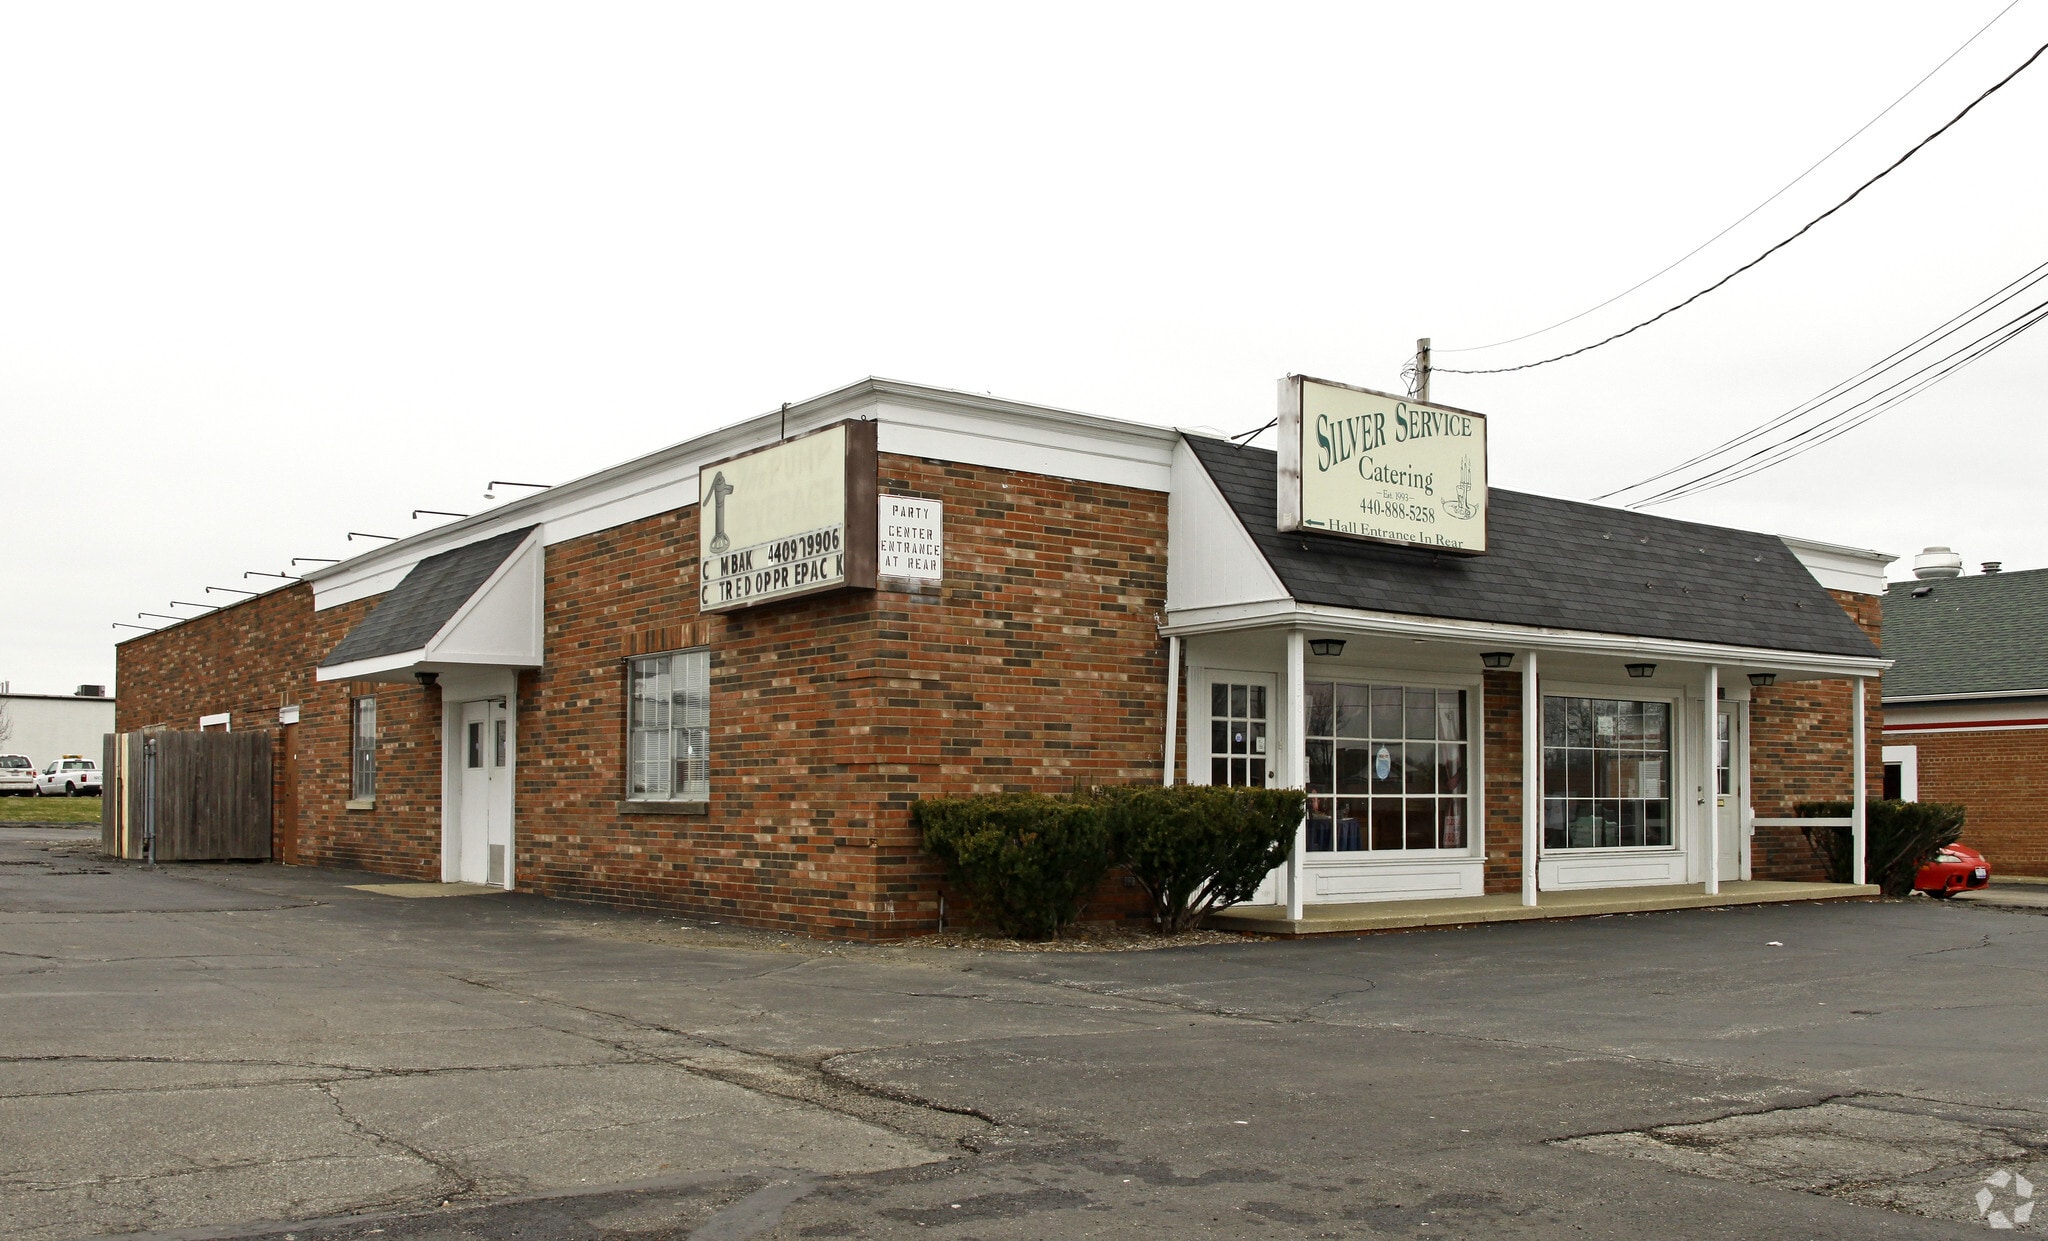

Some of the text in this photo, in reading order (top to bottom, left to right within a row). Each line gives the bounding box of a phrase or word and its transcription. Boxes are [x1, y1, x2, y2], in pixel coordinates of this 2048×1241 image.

[1316, 402, 1473, 472] SILVER SERVICE
[1358, 455, 1434, 496] Catering
[892, 504, 929, 520] PARTY
[1359, 497, 1435, 524] 440-888-5258
[888, 525, 933, 540] CENTER
[1328, 518, 1464, 549] Hall Entrance In Rear
[880, 540, 940, 556] ENTRANCE
[885, 555, 937, 571] AT REAR
